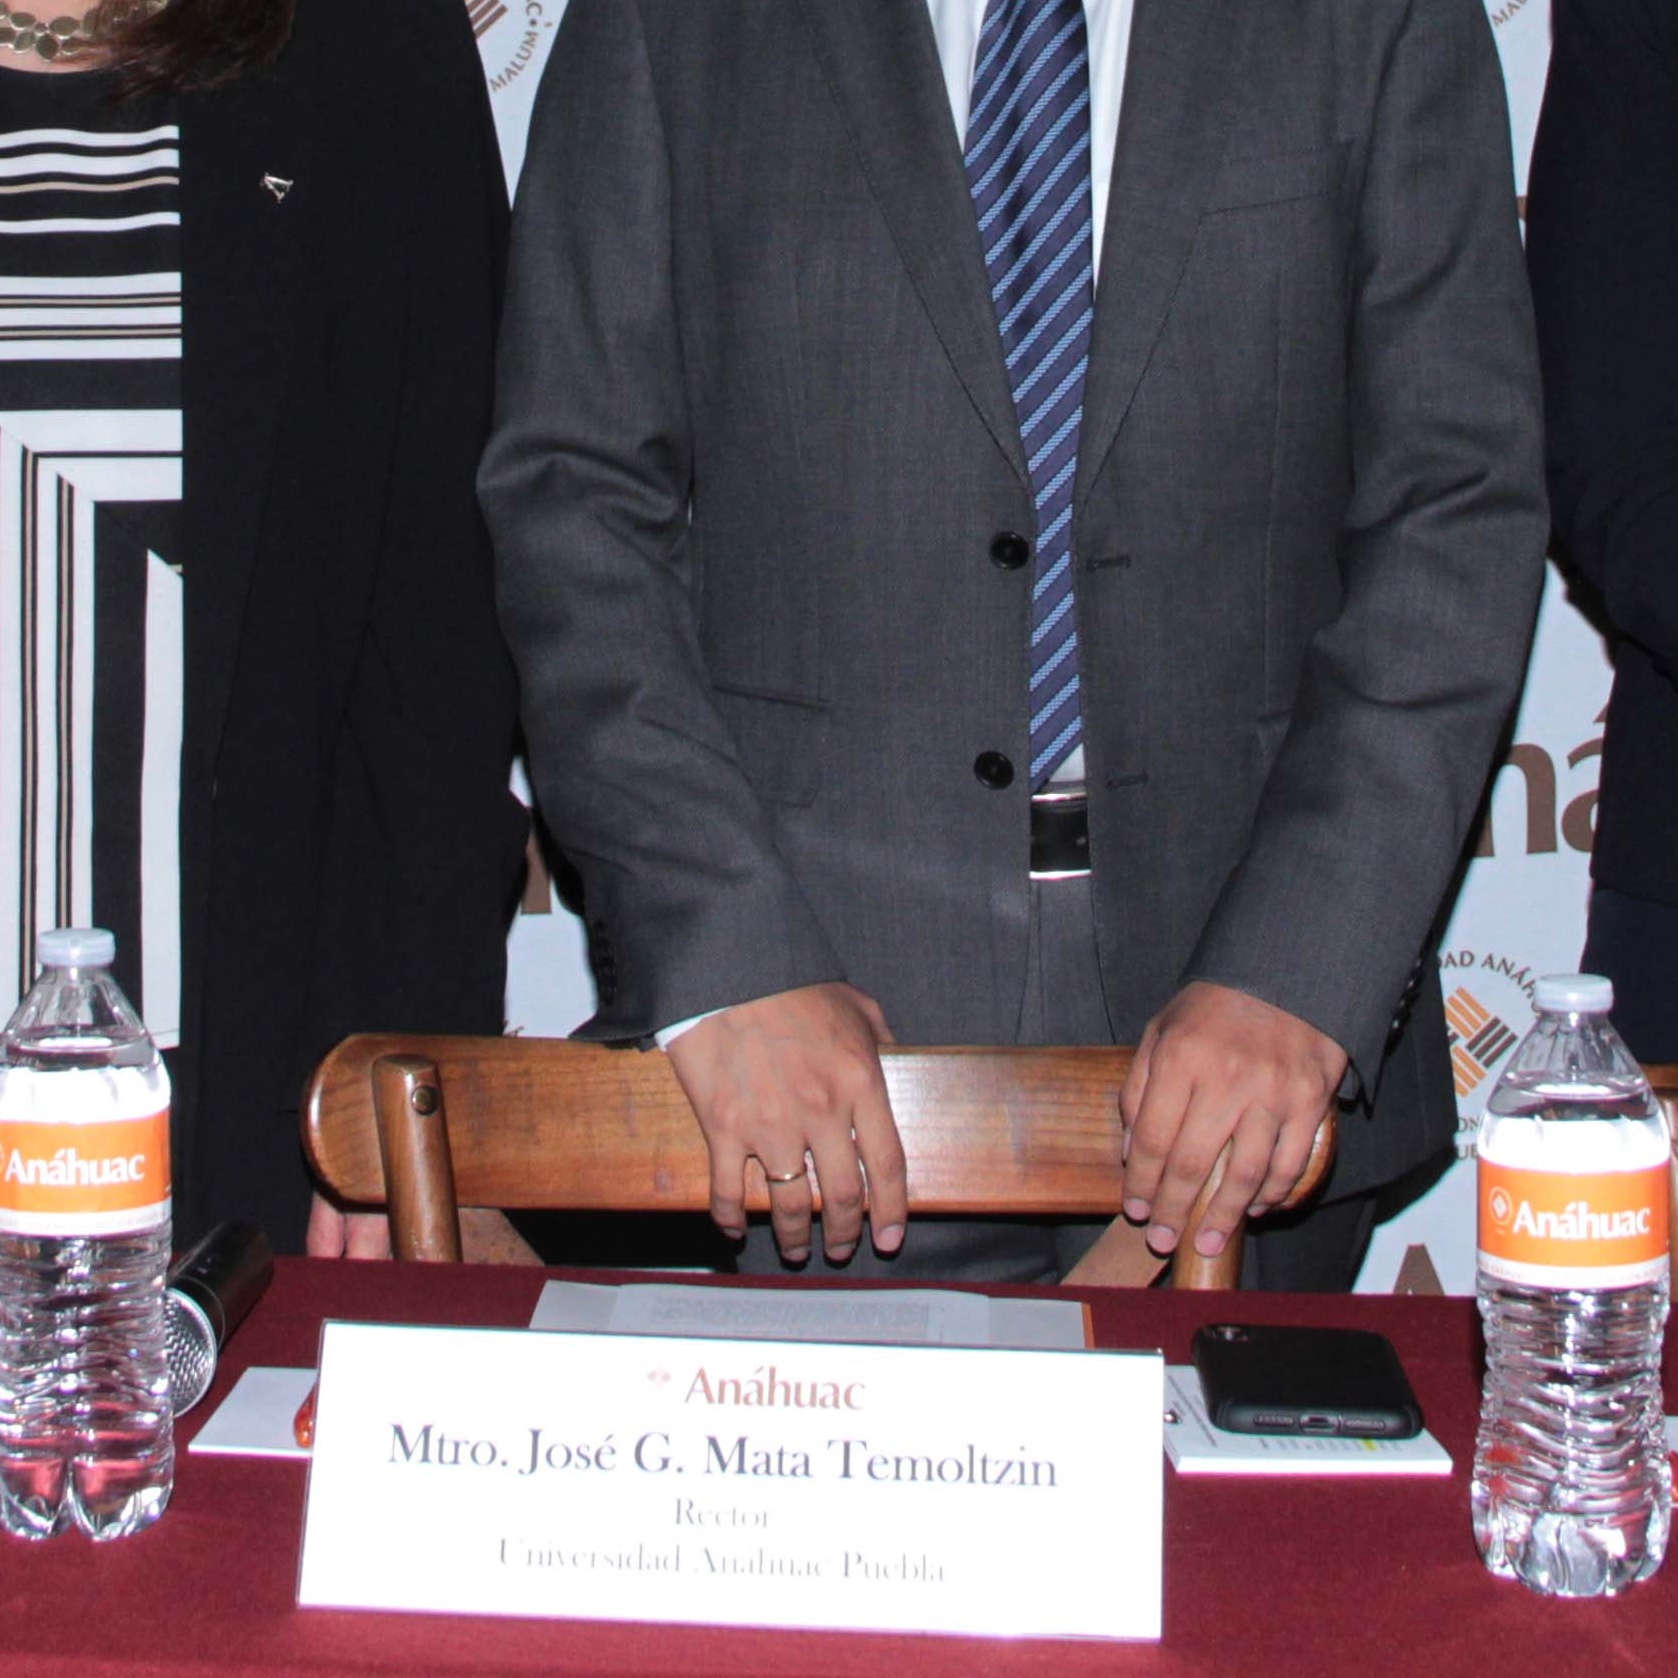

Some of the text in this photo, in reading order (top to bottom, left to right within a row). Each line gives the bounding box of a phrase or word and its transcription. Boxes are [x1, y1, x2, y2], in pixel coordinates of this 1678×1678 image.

[4, 1148, 146, 1186] Anáhuac
[1512, 1200, 1650, 1240] Anáhuac
[684, 1366, 865, 1411] Anáhuac
[387, 1424, 1060, 1487] Mtro. José G. Mata Temoltzin
[498, 1538, 682, 1573] Universidad
